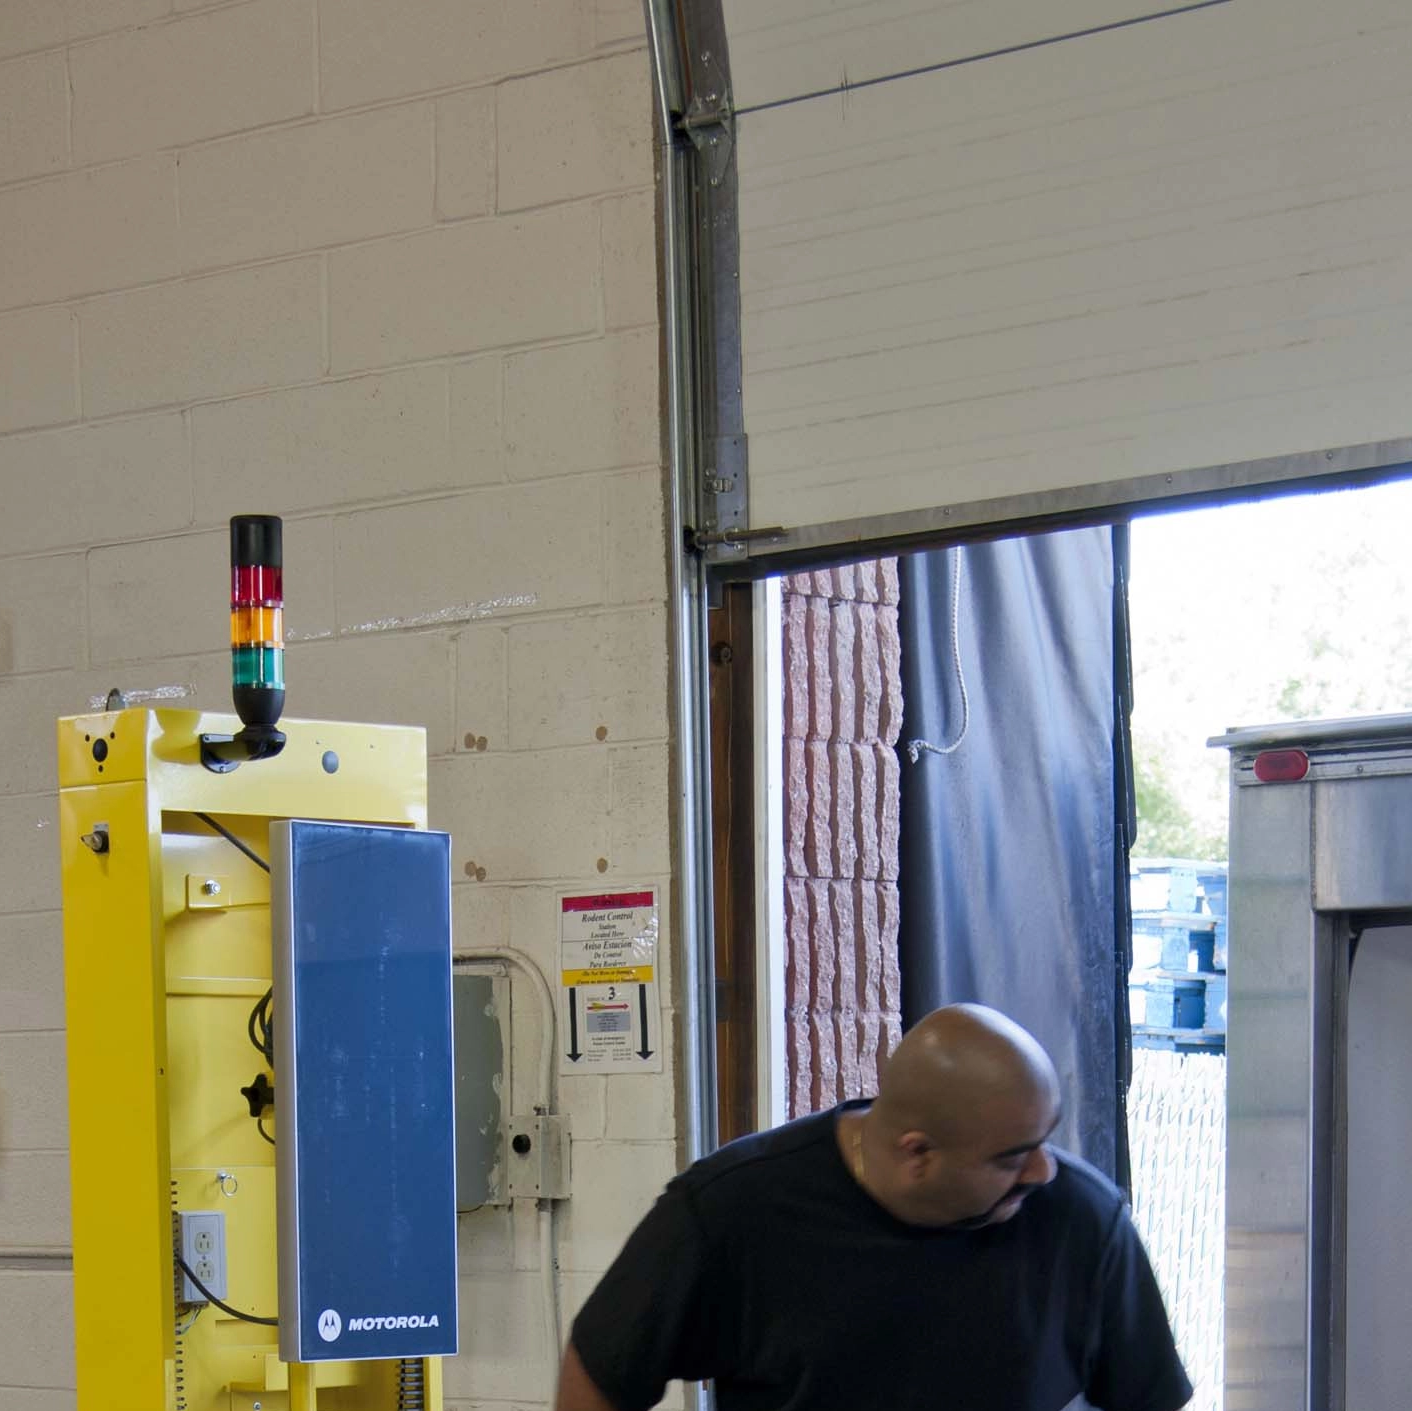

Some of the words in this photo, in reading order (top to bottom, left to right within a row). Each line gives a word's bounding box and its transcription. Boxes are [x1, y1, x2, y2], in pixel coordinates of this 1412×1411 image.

[582, 913, 606, 923] Rodent
[607, 911, 633, 921] Control
[608, 986, 616, 1000] 3
[348, 1314, 439, 1331] MOTOROLA
